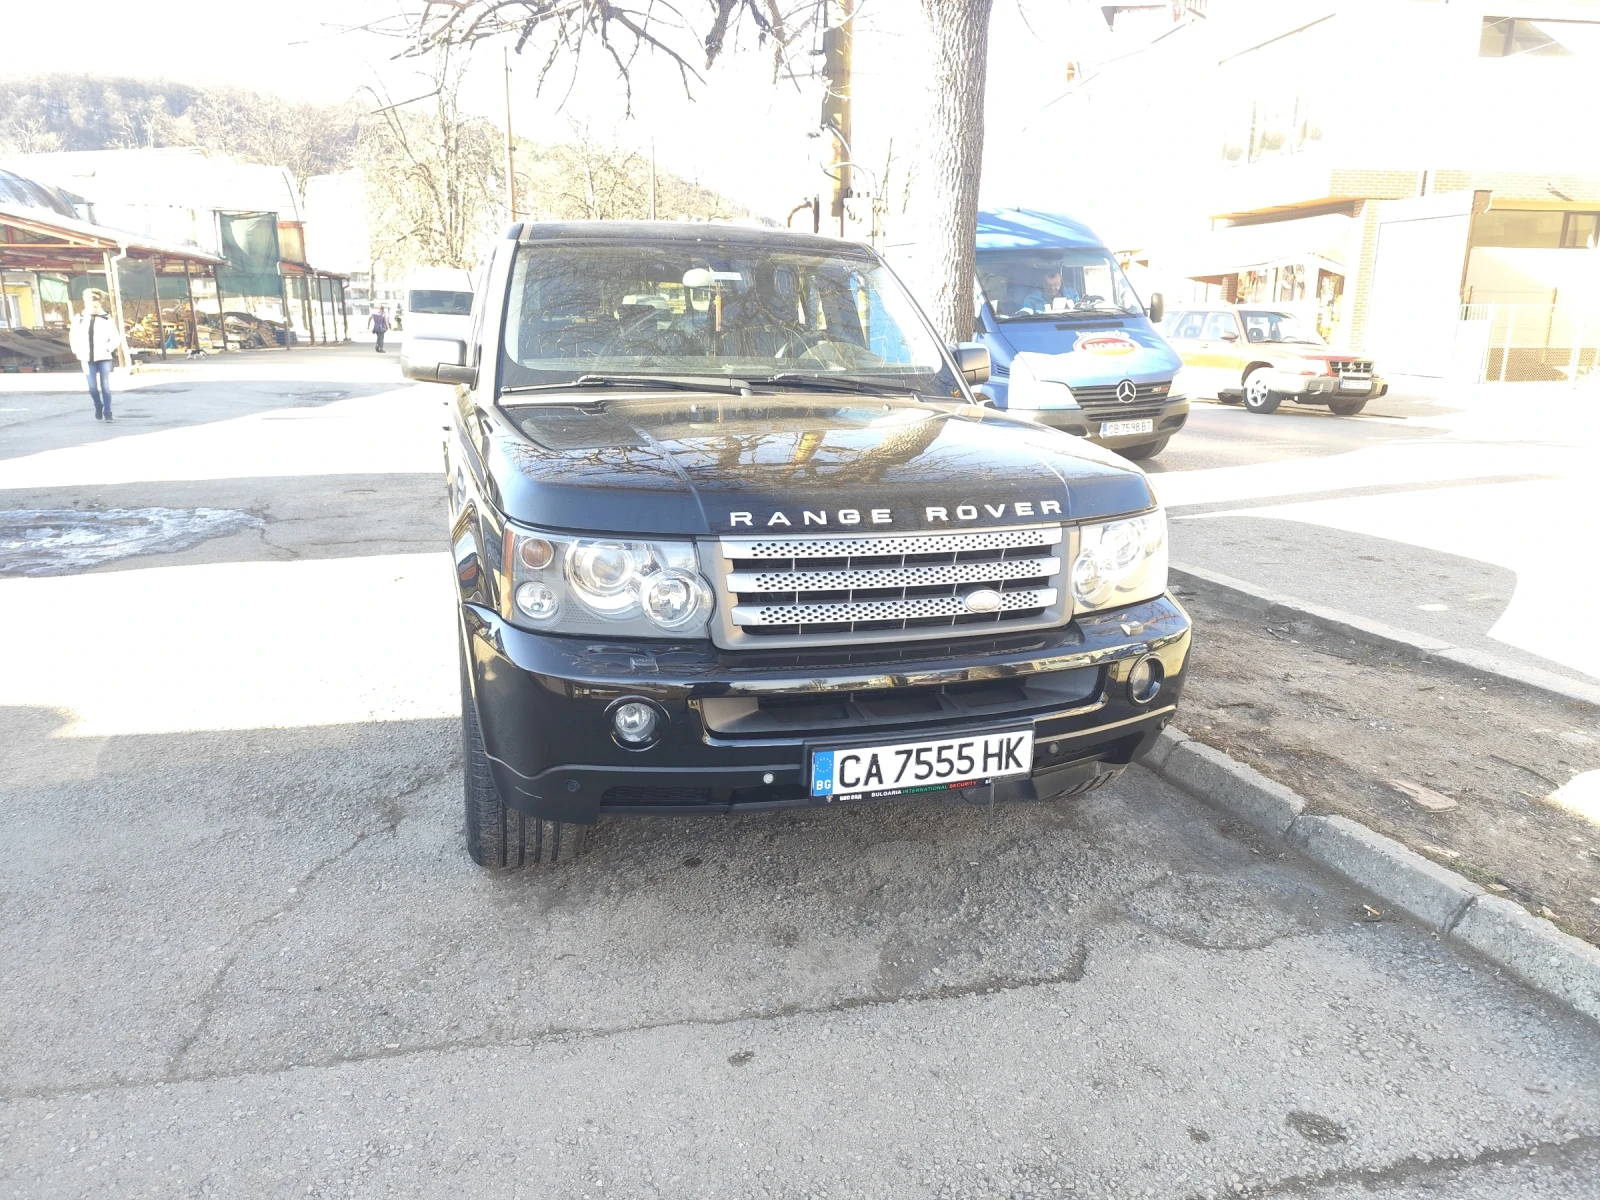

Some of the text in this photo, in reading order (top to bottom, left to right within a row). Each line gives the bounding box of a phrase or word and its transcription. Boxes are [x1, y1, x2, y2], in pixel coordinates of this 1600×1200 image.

[730, 500, 1062, 527] RANGE ROVER
[839, 735, 1026, 788] CA 7555 HK
[816, 779, 831, 790] BG
[871, 789, 902, 797] BULGARIA
[903, 785, 948, 794] INTERNATIONAL
[949, 780, 977, 789] SECURITY
